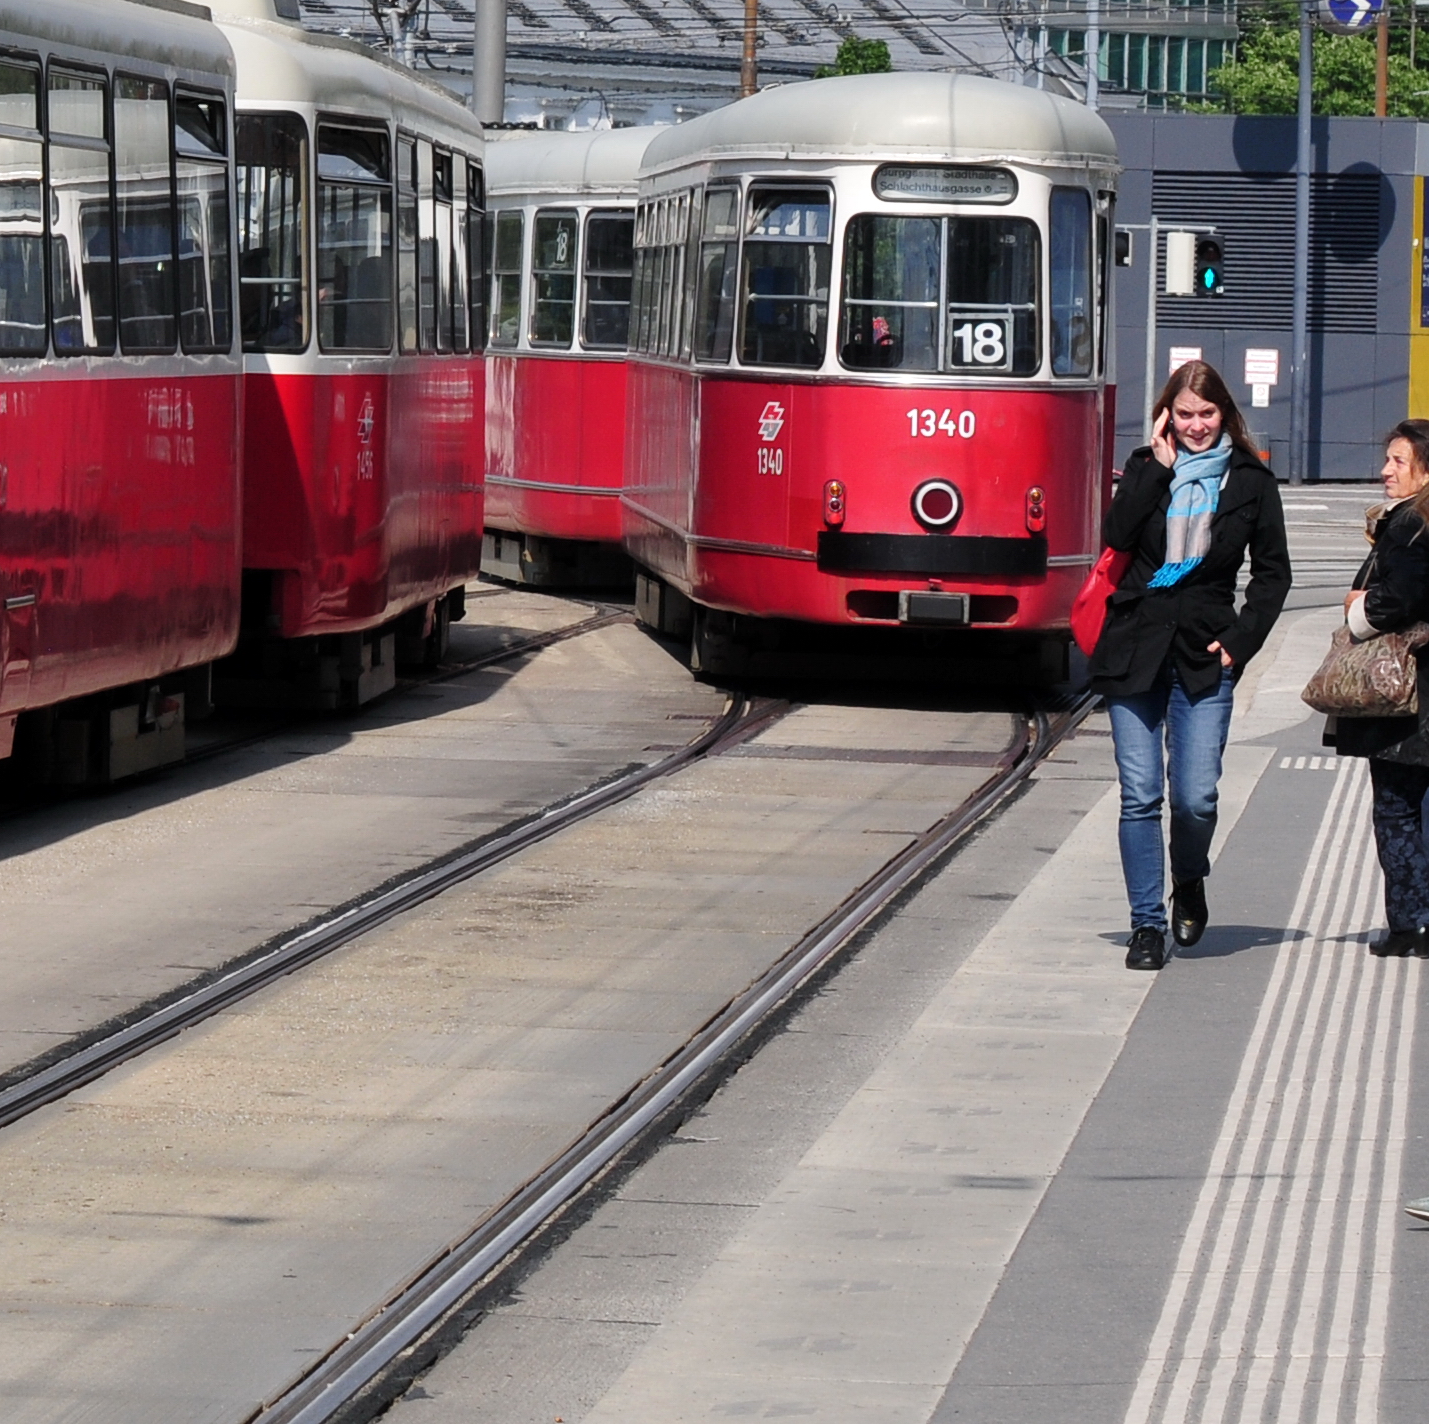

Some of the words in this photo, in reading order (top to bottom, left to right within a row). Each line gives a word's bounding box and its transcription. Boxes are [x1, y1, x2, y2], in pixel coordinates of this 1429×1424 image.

[879, 180, 982, 194] Schlachthausgasse
[556, 231, 568, 262] 18
[953, 321, 1005, 364] 18
[906, 408, 976, 439] 1340
[756, 447, 783, 476] 1340
